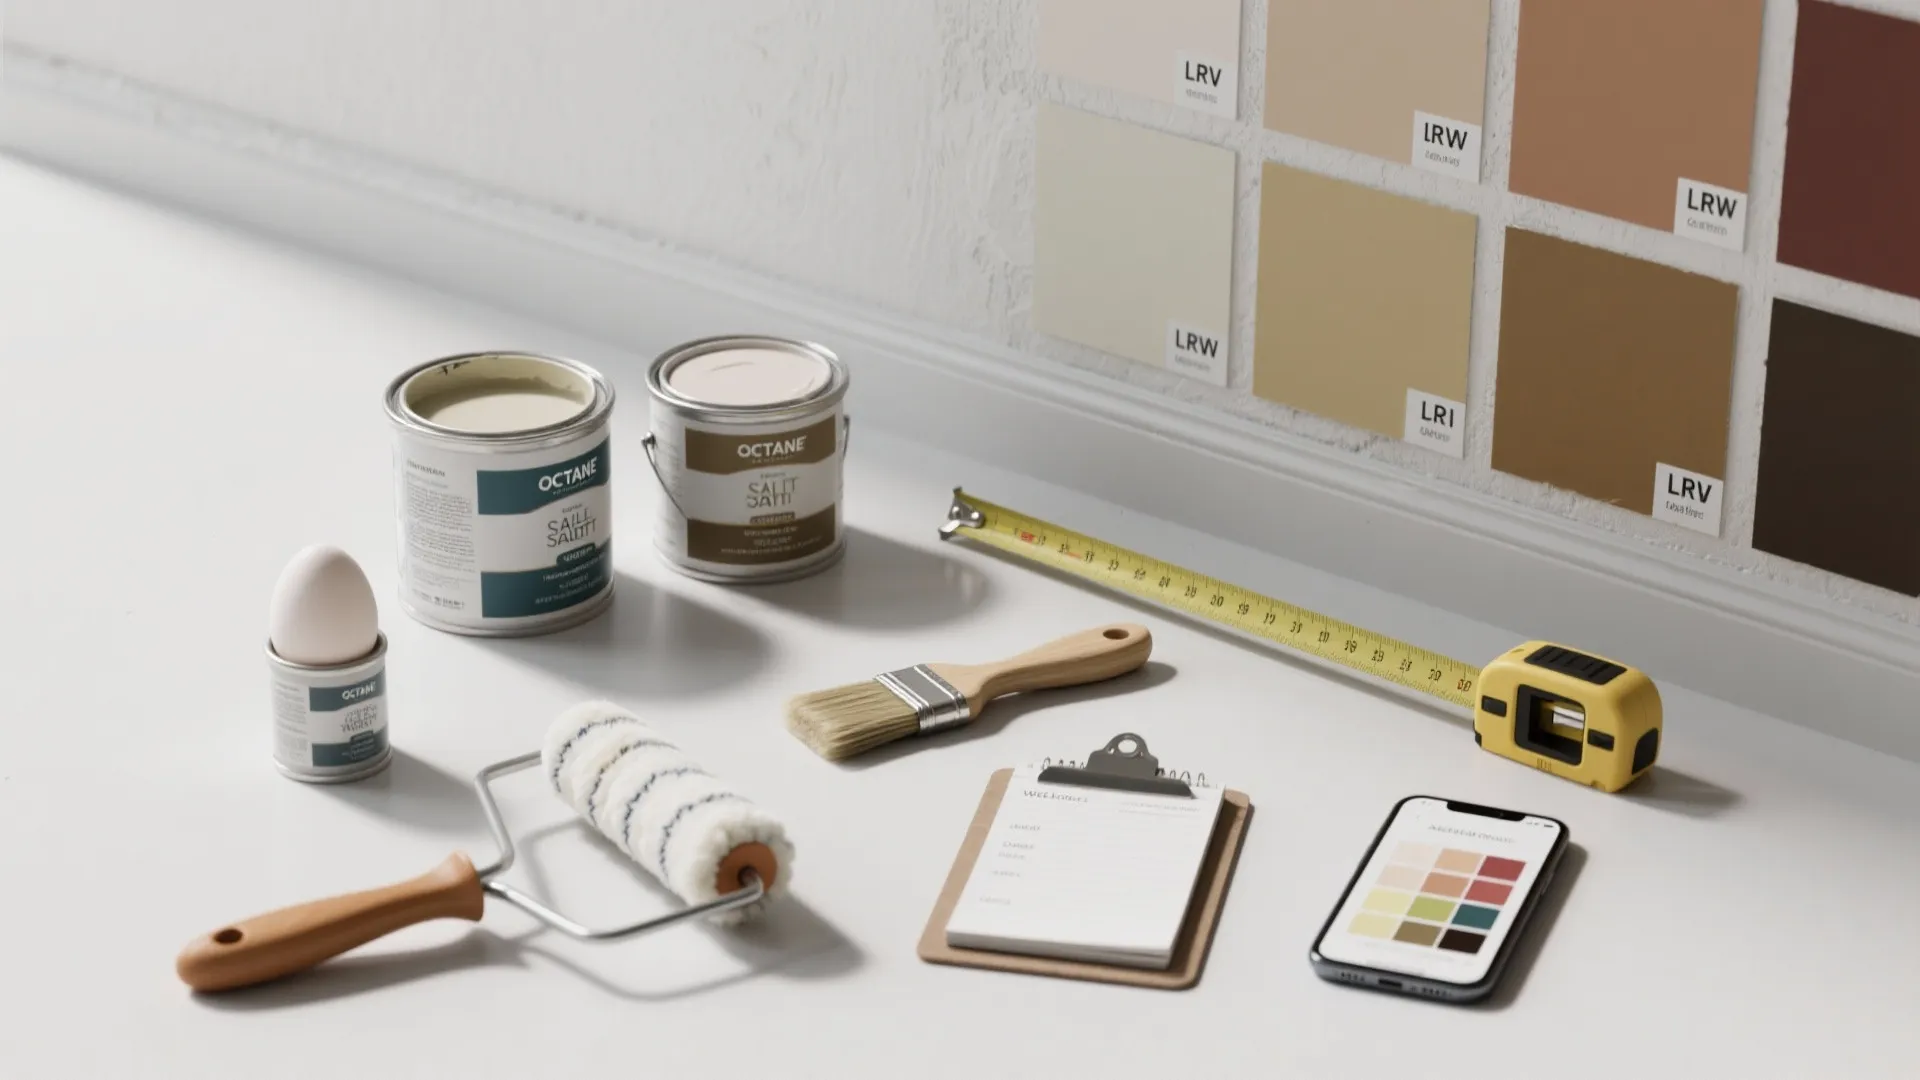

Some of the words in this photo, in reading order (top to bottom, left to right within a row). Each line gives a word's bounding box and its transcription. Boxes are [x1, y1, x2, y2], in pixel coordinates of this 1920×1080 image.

[1185, 60, 1222, 88] LRV
[1424, 121, 1468, 151] LRW
[1687, 187, 1738, 220] LRW
[1175, 328, 1218, 359] LRW
[1421, 400, 1454, 428] LRI
[737, 435, 807, 458] OCTANE
[538, 456, 598, 492] OCTANE
[1667, 473, 1712, 504] LRV
